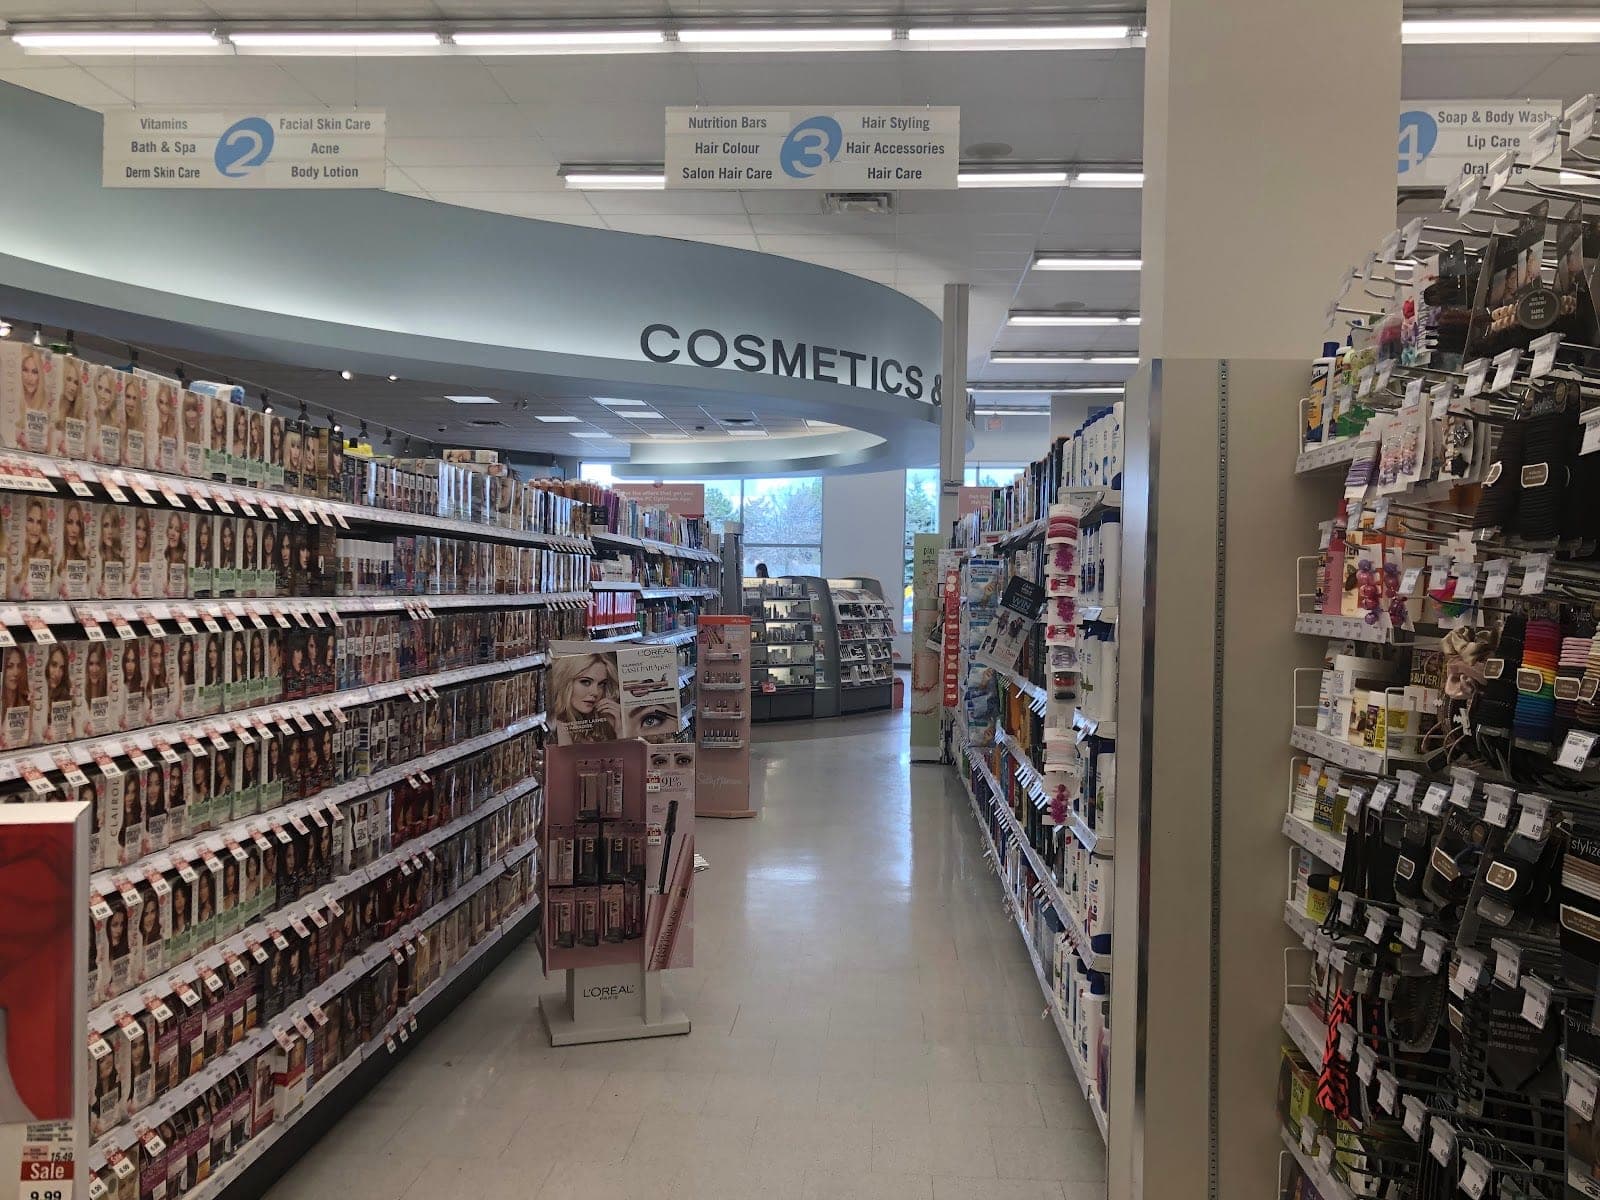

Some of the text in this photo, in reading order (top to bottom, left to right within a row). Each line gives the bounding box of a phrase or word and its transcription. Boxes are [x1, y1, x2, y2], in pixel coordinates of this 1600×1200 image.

[140, 118, 188, 130] Vitamins
[279, 118, 371, 130] Facial Skin Care
[688, 116, 767, 129] Nutrition Bars
[861, 116, 930, 131] Hair Styling
[1438, 111, 1551, 125] Soap & Body Wash
[131, 141, 196, 156] Bath & Spa
[310, 142, 340, 155] Acne
[695, 142, 760, 154] Hair Colour
[846, 142, 945, 155] Hair Accessories
[1398, 124, 1424, 172] 4
[1467, 135, 1521, 150] Lip Care
[225, 128, 264, 174] 2
[791, 128, 831, 175] 3
[125, 166, 200, 179] Derm Skin Care
[291, 166, 359, 180] Body Lotion
[682, 167, 773, 179] Salon Hair Care
[867, 167, 922, 179] Hair Care
[1463, 162, 1489, 175] Oral
[640, 323, 923, 400] COSMETICS
[35, 649, 43, 711] CLAIROL
[110, 780, 120, 837] CLAIROL
[30, 1162, 65, 1179] Sale
[30, 1191, 62, 1200] 999
